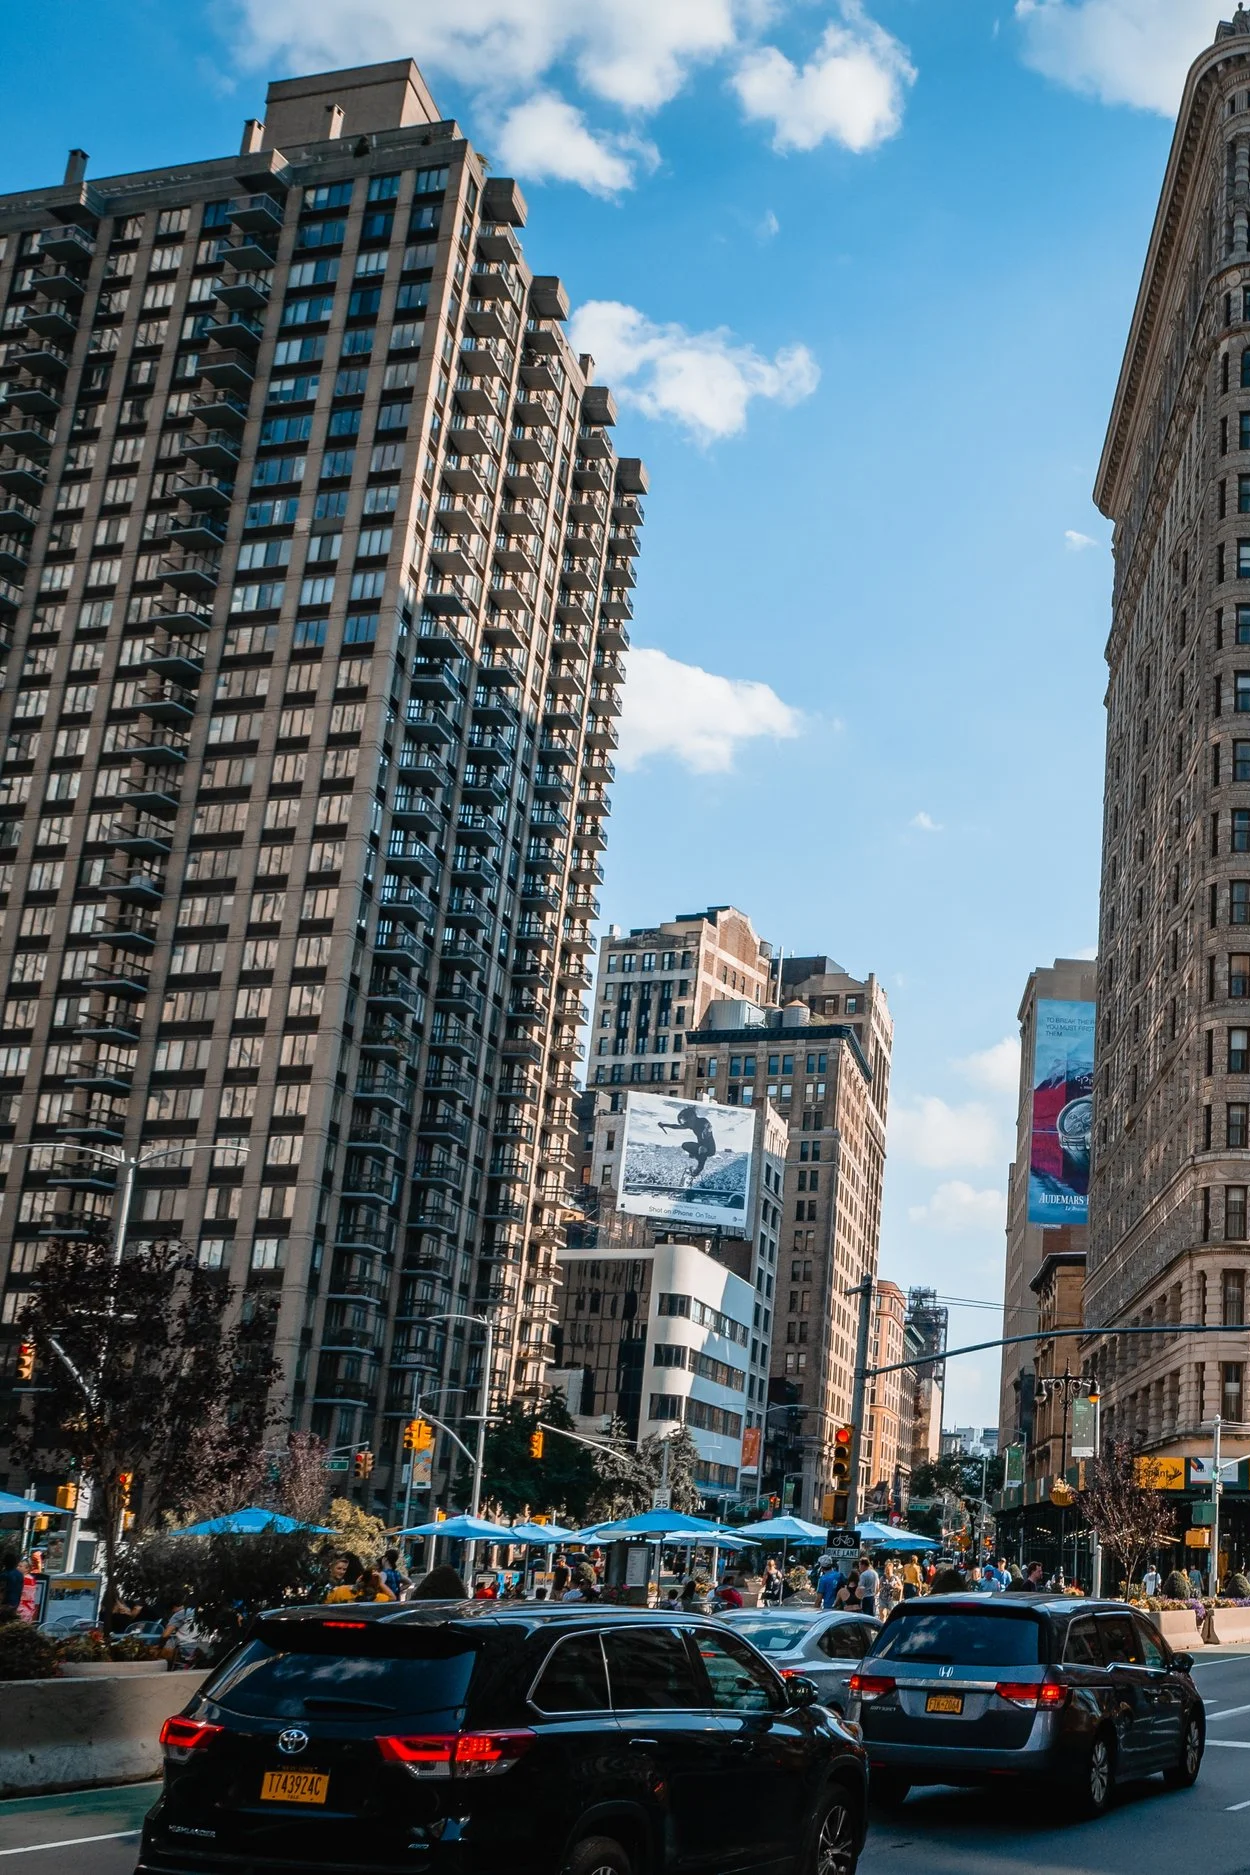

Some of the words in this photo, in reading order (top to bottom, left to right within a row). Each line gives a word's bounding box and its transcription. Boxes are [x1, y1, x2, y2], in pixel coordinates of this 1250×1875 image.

[1039, 1192, 1084, 1205] AUDEMARS
[649, 1206, 663, 1215] Shot
[672, 1209, 694, 1217] iPhone
[705, 1212, 717, 1220] Tour
[655, 1499, 669, 1509] 25
[828, 1548, 841, 1557] BIKE
[842, 1548, 859, 1558] LANE
[268, 1773, 322, 1796] T743924C
